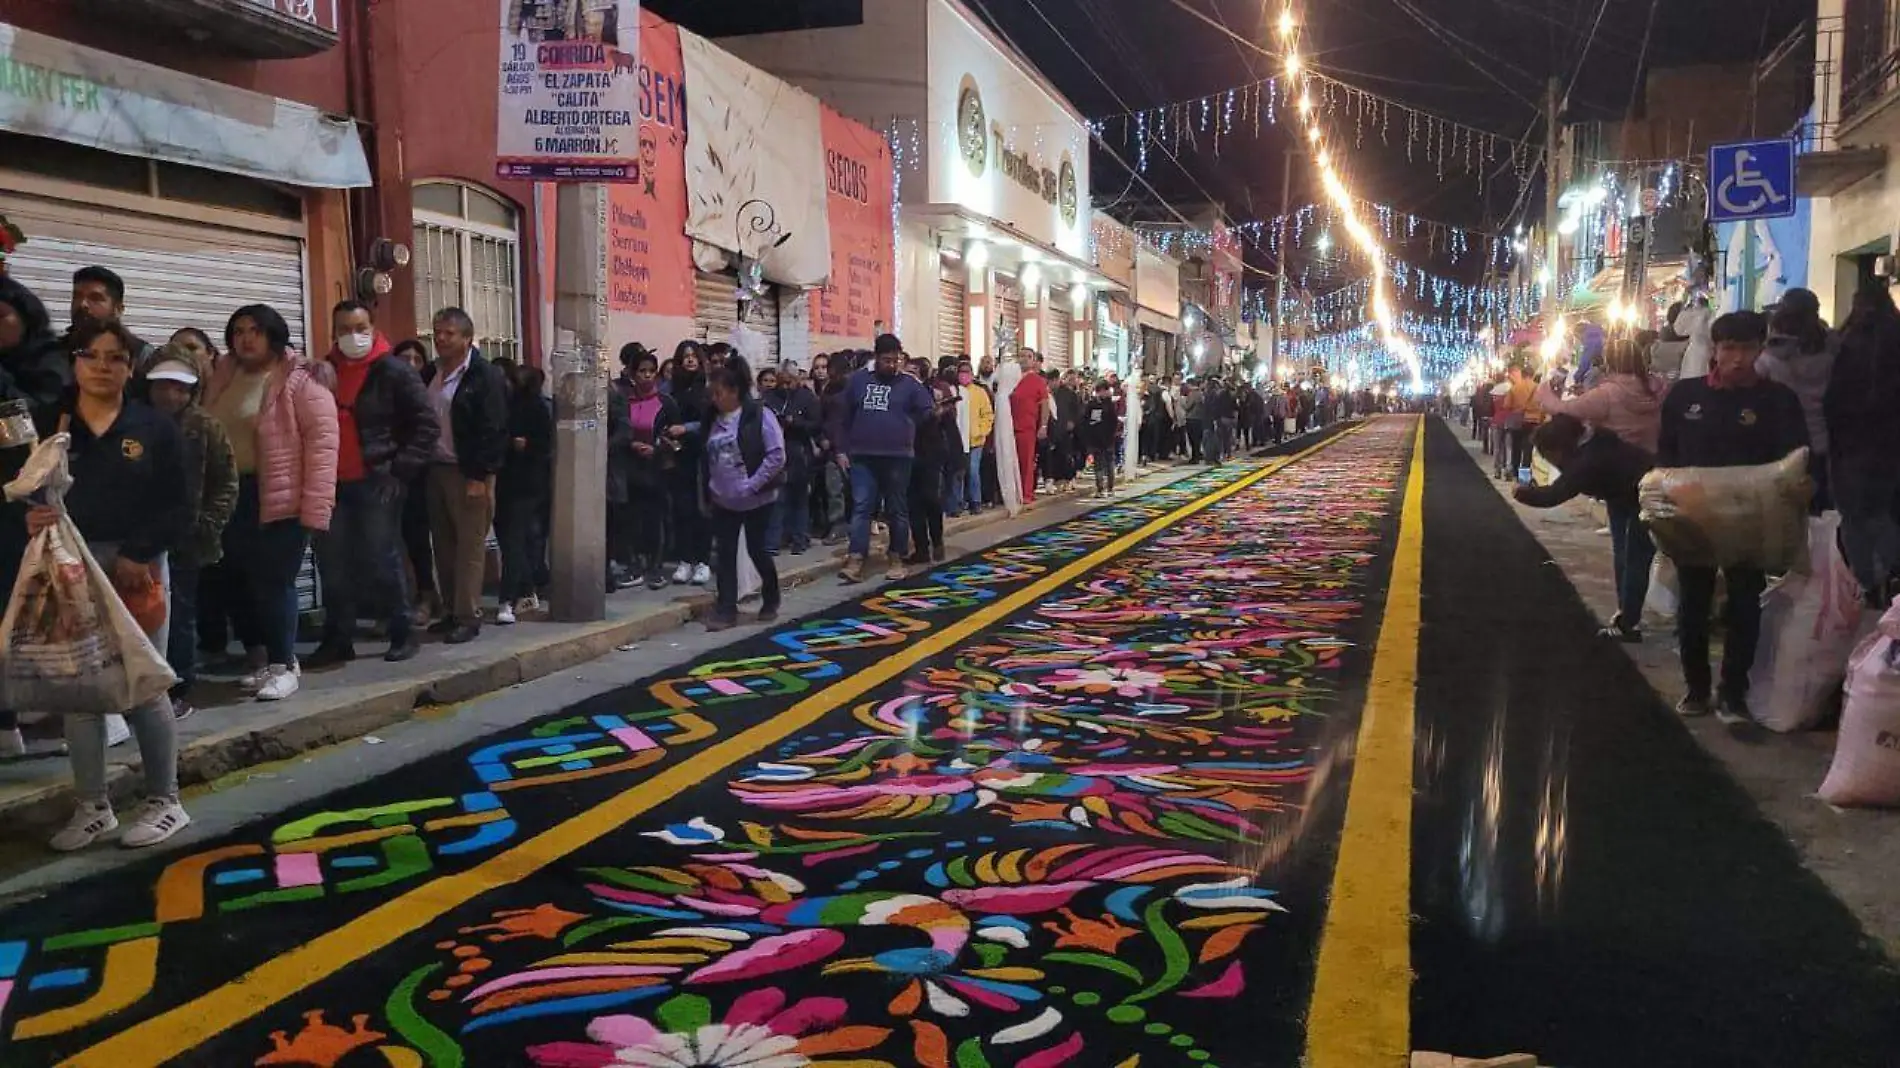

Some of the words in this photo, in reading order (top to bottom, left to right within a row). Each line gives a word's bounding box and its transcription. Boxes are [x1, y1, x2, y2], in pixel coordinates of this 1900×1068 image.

[511, 43, 527, 61] 19
[537, 44, 605, 64] CORRIDA
[551, 91, 605, 107] "CALITA"
[525, 109, 580, 125] ALBERTO
[581, 109, 631, 125] ORTEGA
[827, 148, 868, 204] SECOS
[864, 383, 892, 411] H
